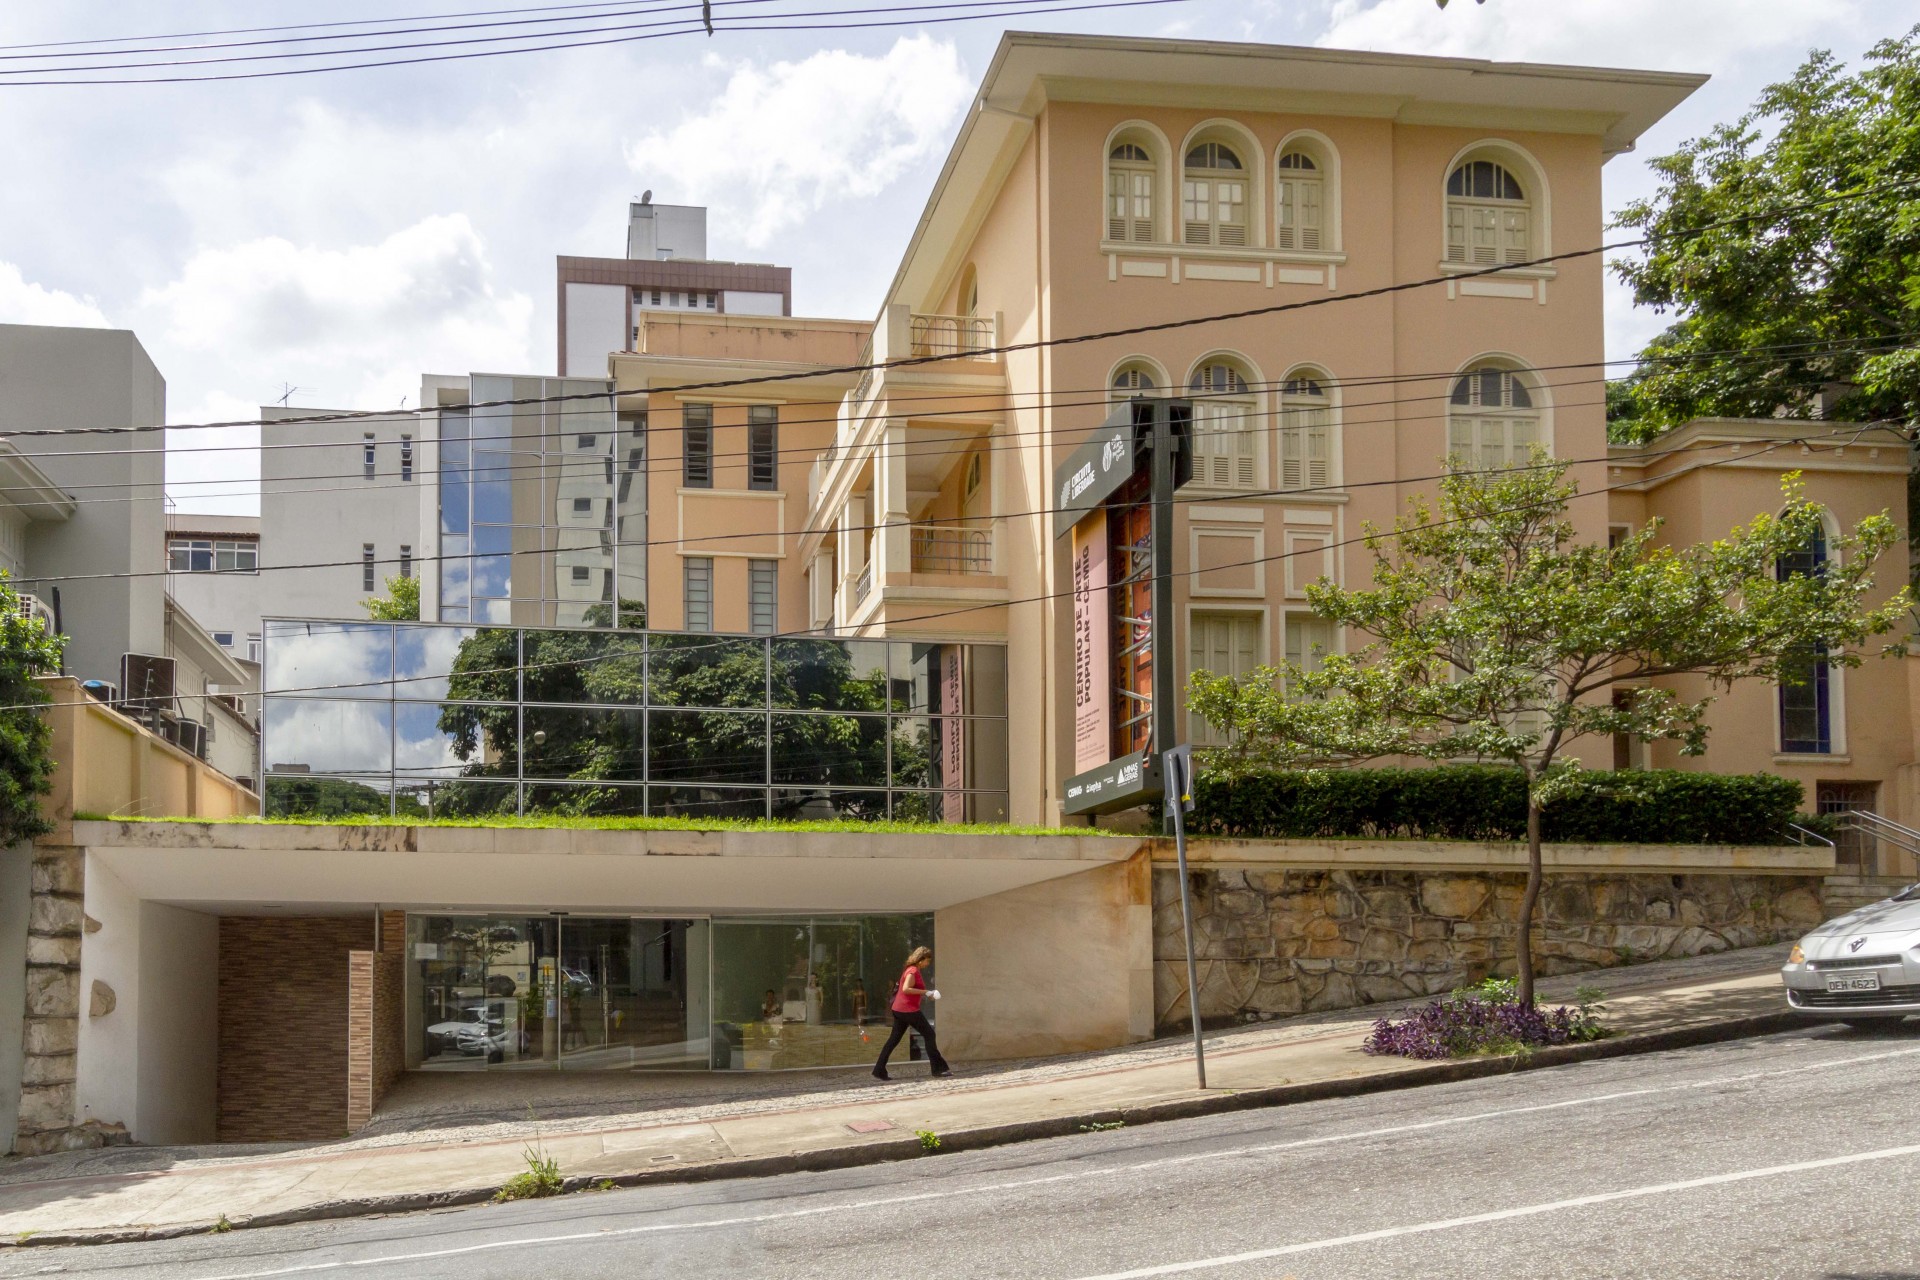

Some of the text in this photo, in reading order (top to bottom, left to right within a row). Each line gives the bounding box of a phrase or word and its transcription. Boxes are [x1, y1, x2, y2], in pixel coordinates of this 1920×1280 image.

[1082, 545, 1090, 604] CEMIG
[1075, 608, 1082, 634] DE
[1076, 637, 1084, 708] CENTRO
[1123, 762, 1138, 775] MINAS
[1124, 770, 1139, 782] GERAIS
